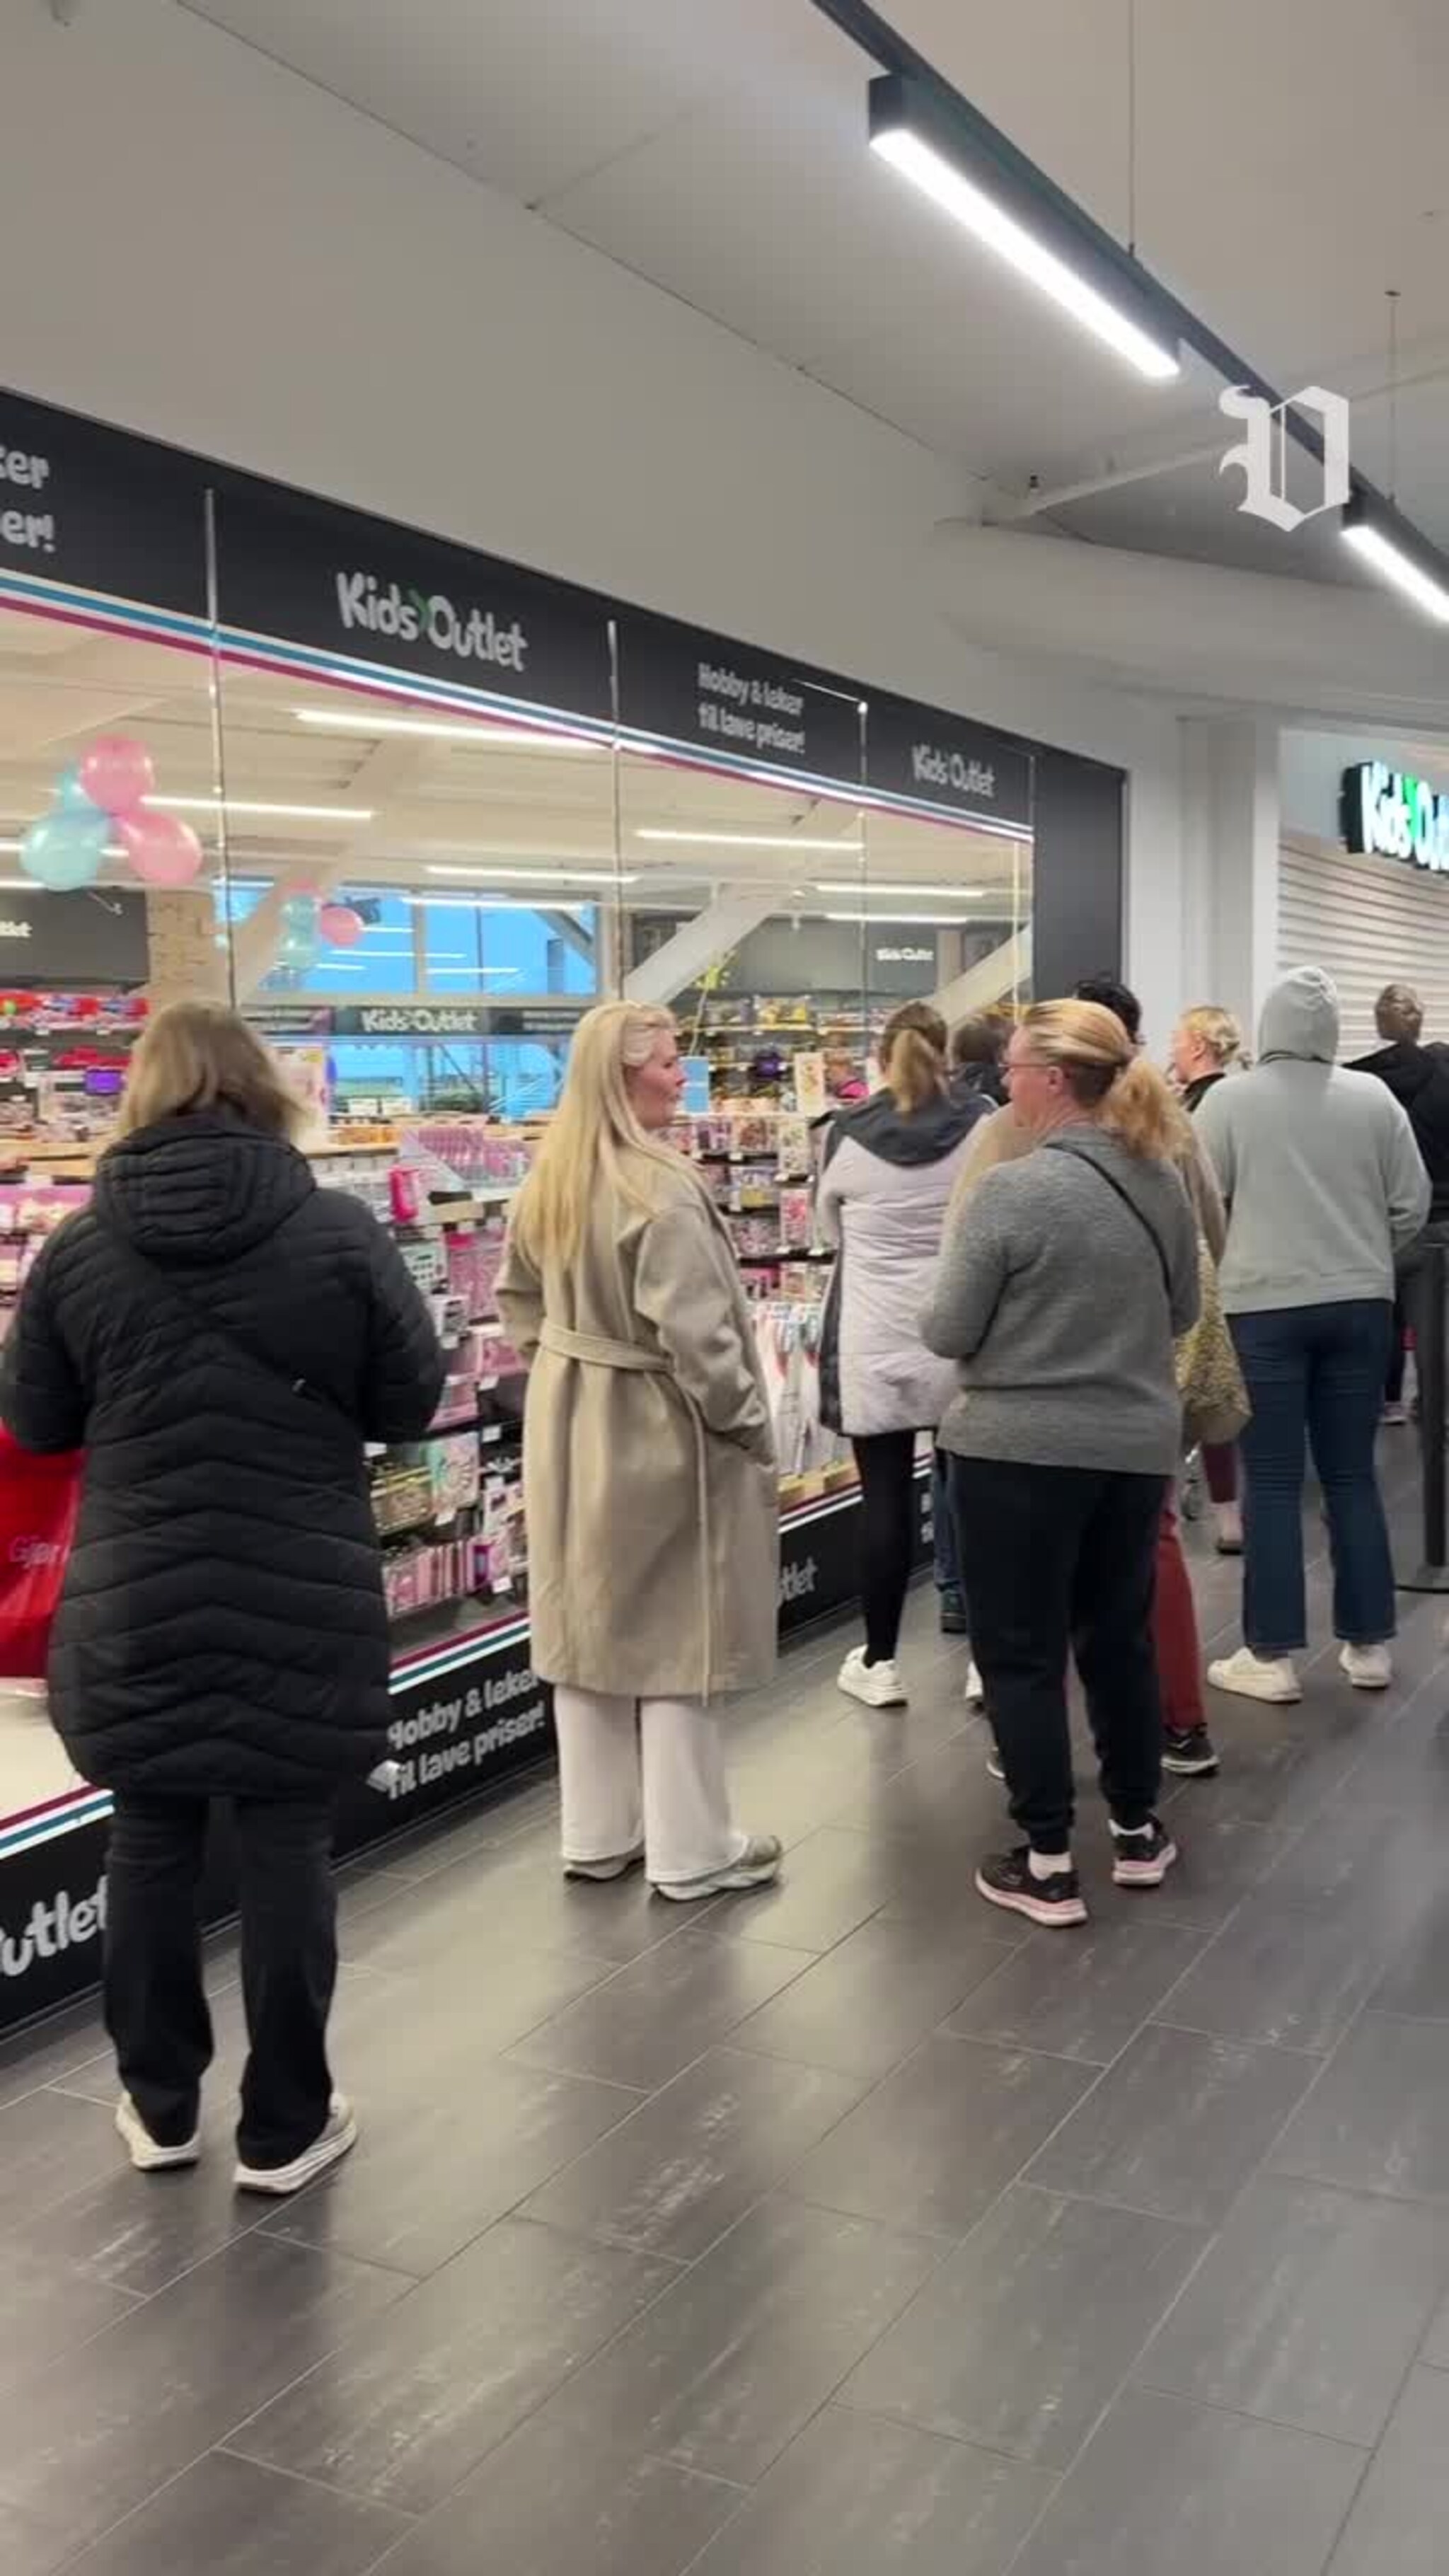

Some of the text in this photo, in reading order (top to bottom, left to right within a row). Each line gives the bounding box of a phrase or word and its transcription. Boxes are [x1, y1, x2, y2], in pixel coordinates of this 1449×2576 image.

[698, 662, 749, 706] Hobby
[464, 1688, 483, 1718] &
[419, 1740, 472, 1784] lave
[473, 1700, 545, 1764] priser!
